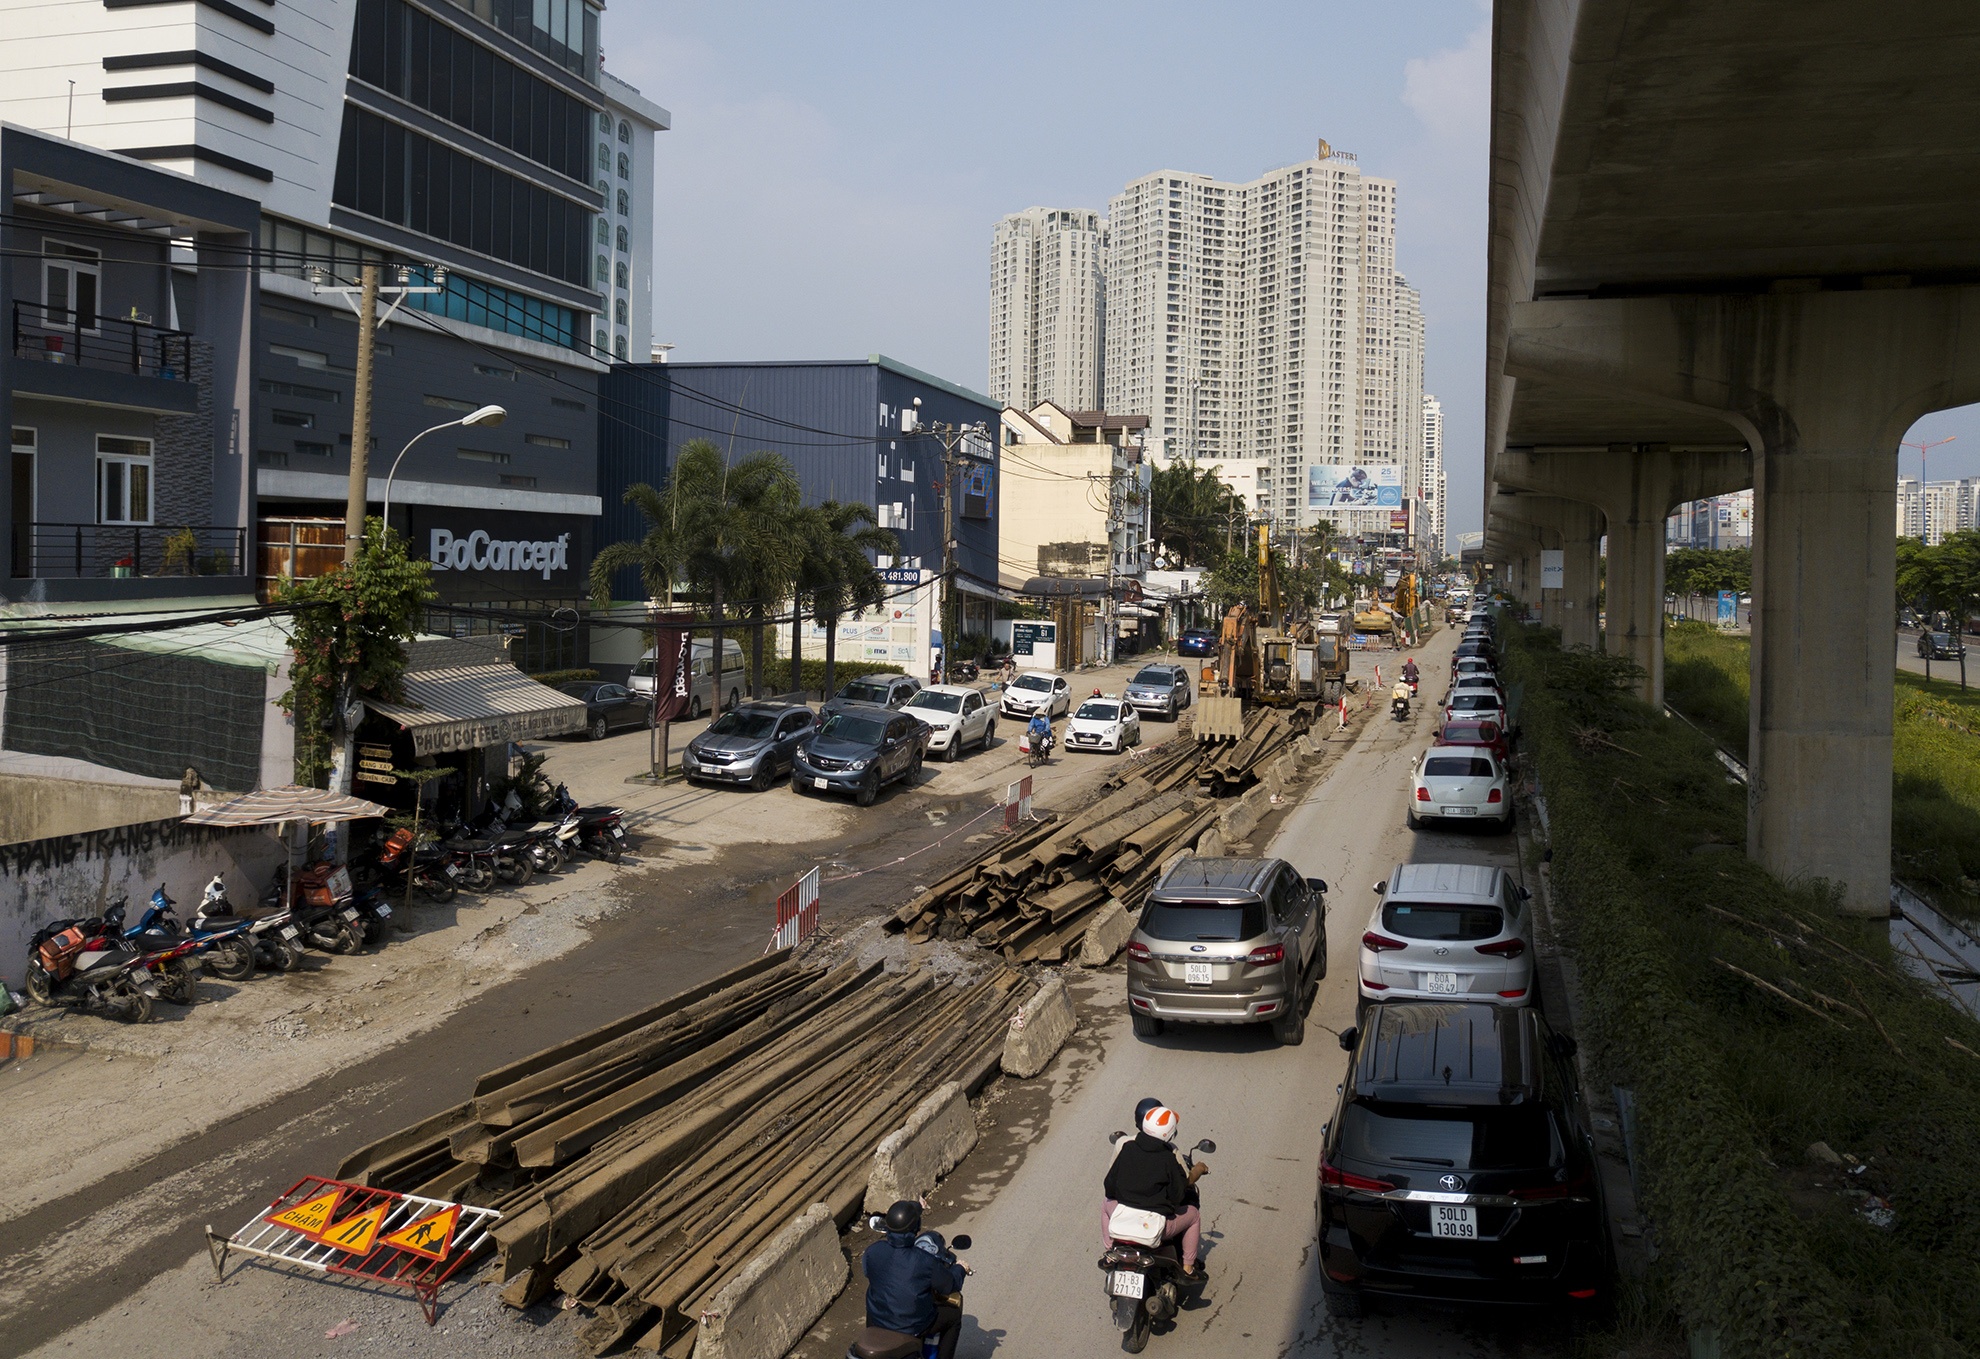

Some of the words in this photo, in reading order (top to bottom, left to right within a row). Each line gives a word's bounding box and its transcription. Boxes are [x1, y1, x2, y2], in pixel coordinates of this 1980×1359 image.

[430, 528, 569, 580] BoConcept
[887, 572, 918, 581] 481.800
[453, 725, 500, 746] COFFEE
[1190, 965, 1207, 973] 50LD
[1187, 973, 1210, 982] 096.15
[1434, 974, 1450, 983] 60A
[310, 1203, 328, 1213] ĐI
[283, 1211, 323, 1228] CHẬM
[1440, 1208, 1468, 1221] 50LD
[1437, 1222, 1473, 1237] 130.99
[1118, 1274, 1140, 1285] 71-B3
[1115, 1284, 1141, 1296] 271.79
